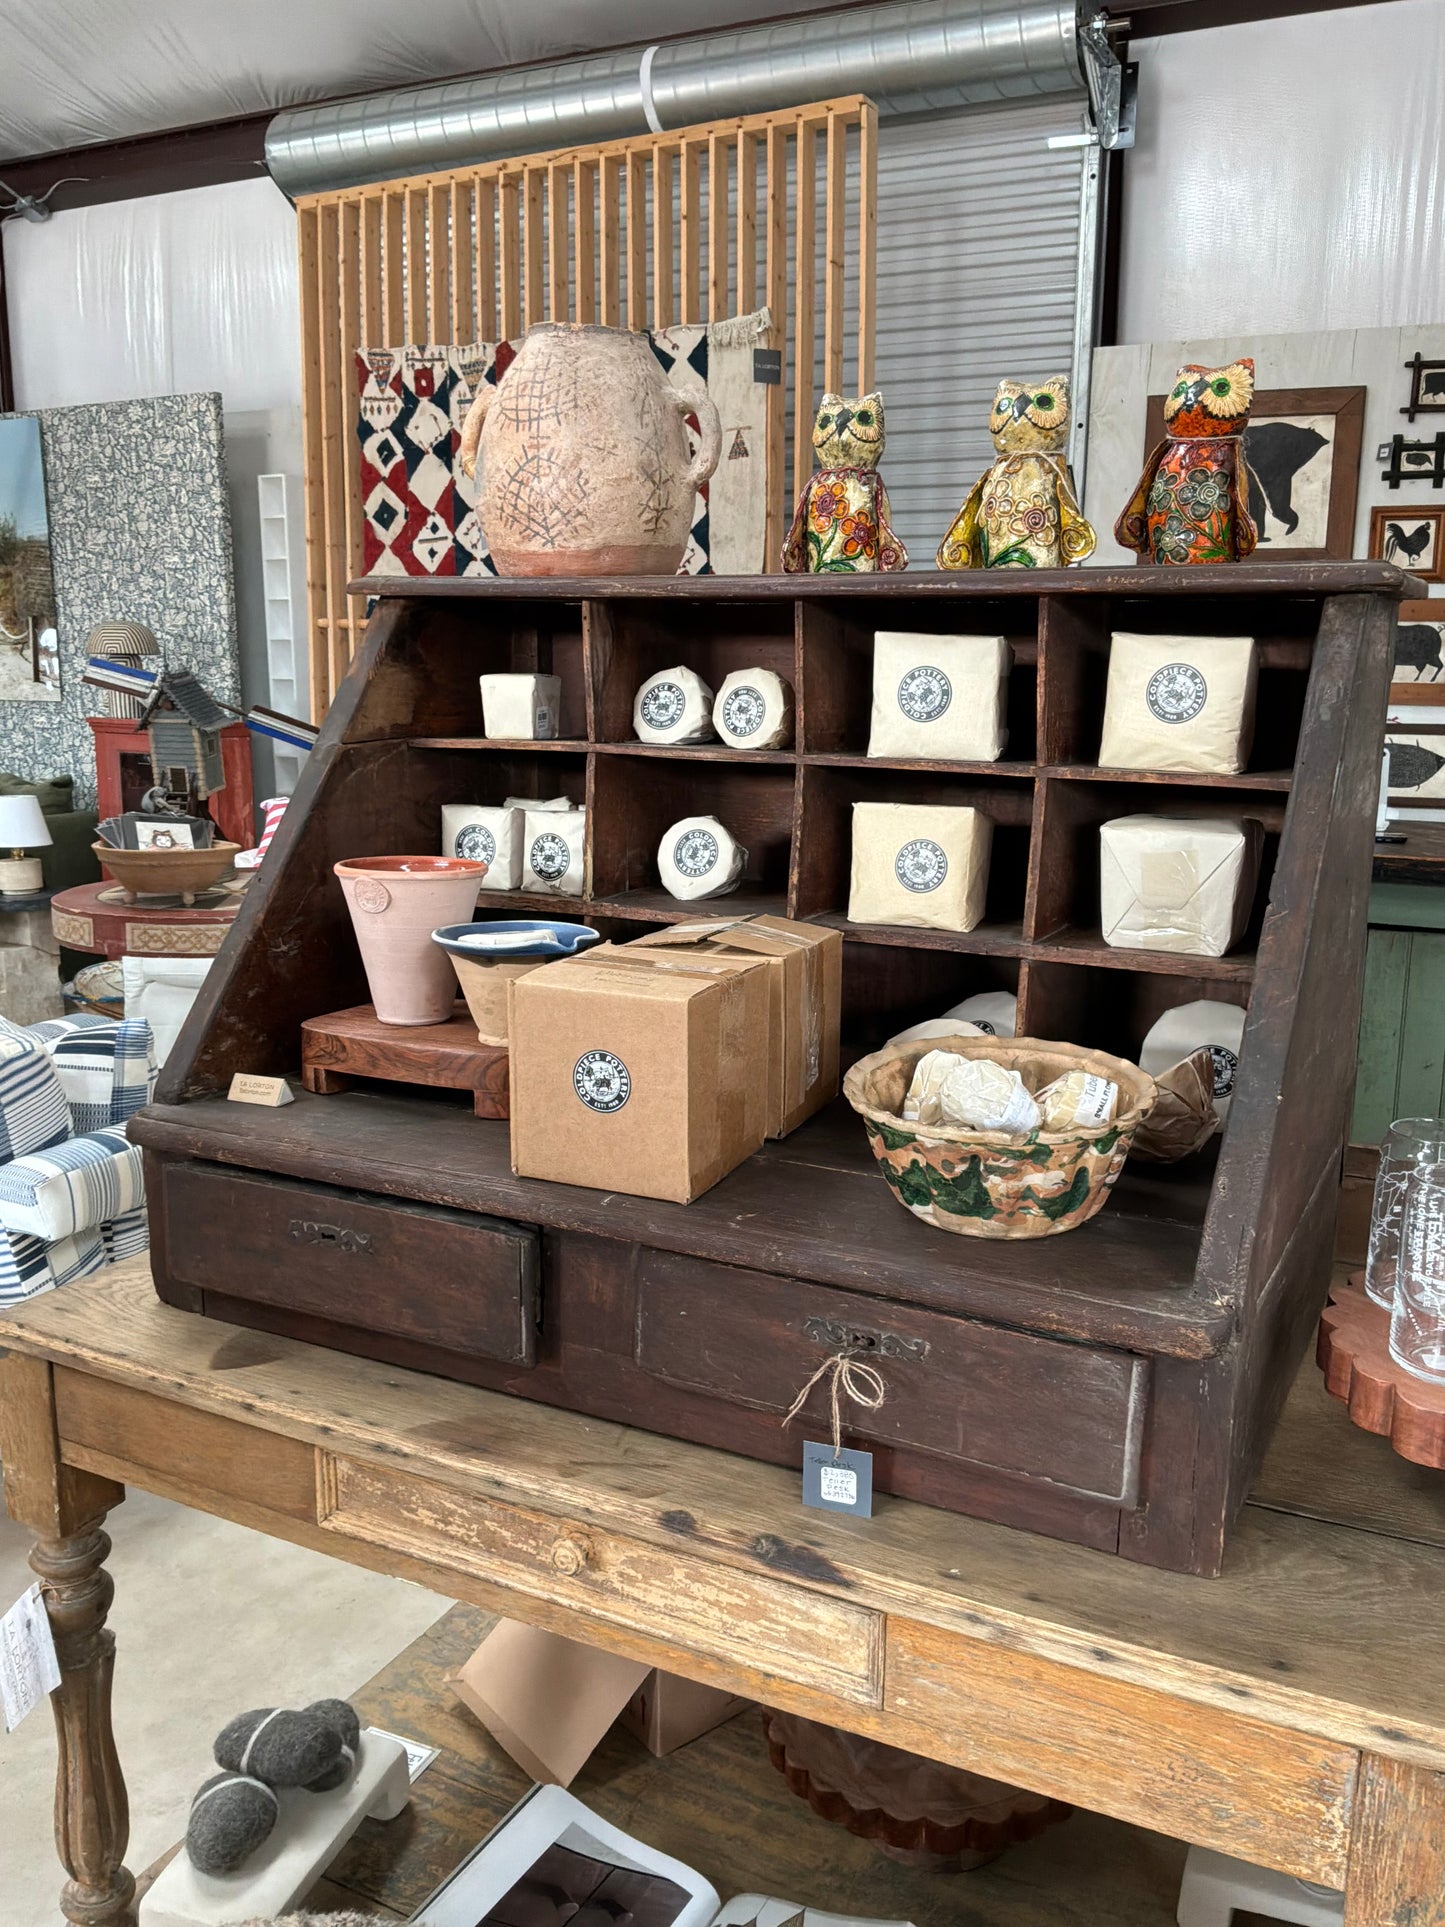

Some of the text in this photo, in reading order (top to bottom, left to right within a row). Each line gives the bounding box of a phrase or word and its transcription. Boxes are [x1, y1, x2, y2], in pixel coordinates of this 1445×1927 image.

[643, 685, 684, 720] COLDPIECE POTTERY
[901, 677, 927, 719] COLDPIECE
[914, 669, 949, 690] POTTERY
[1149, 666, 1204, 719] COLDPIECE POTTERY
[724, 694, 763, 734] COLDPIECE POTTERY
[531, 836, 568, 872] COLDPIECE POTTERY
[678, 832, 716, 875] COLDPIECE POTTERY
[897, 842, 945, 887] COLDPIECE POTTERY
[248, 1081, 275, 1090] LORTON
[576, 1053, 628, 1101] COLDPIECE POTTERY
[823, 1476, 852, 1485] Teller
